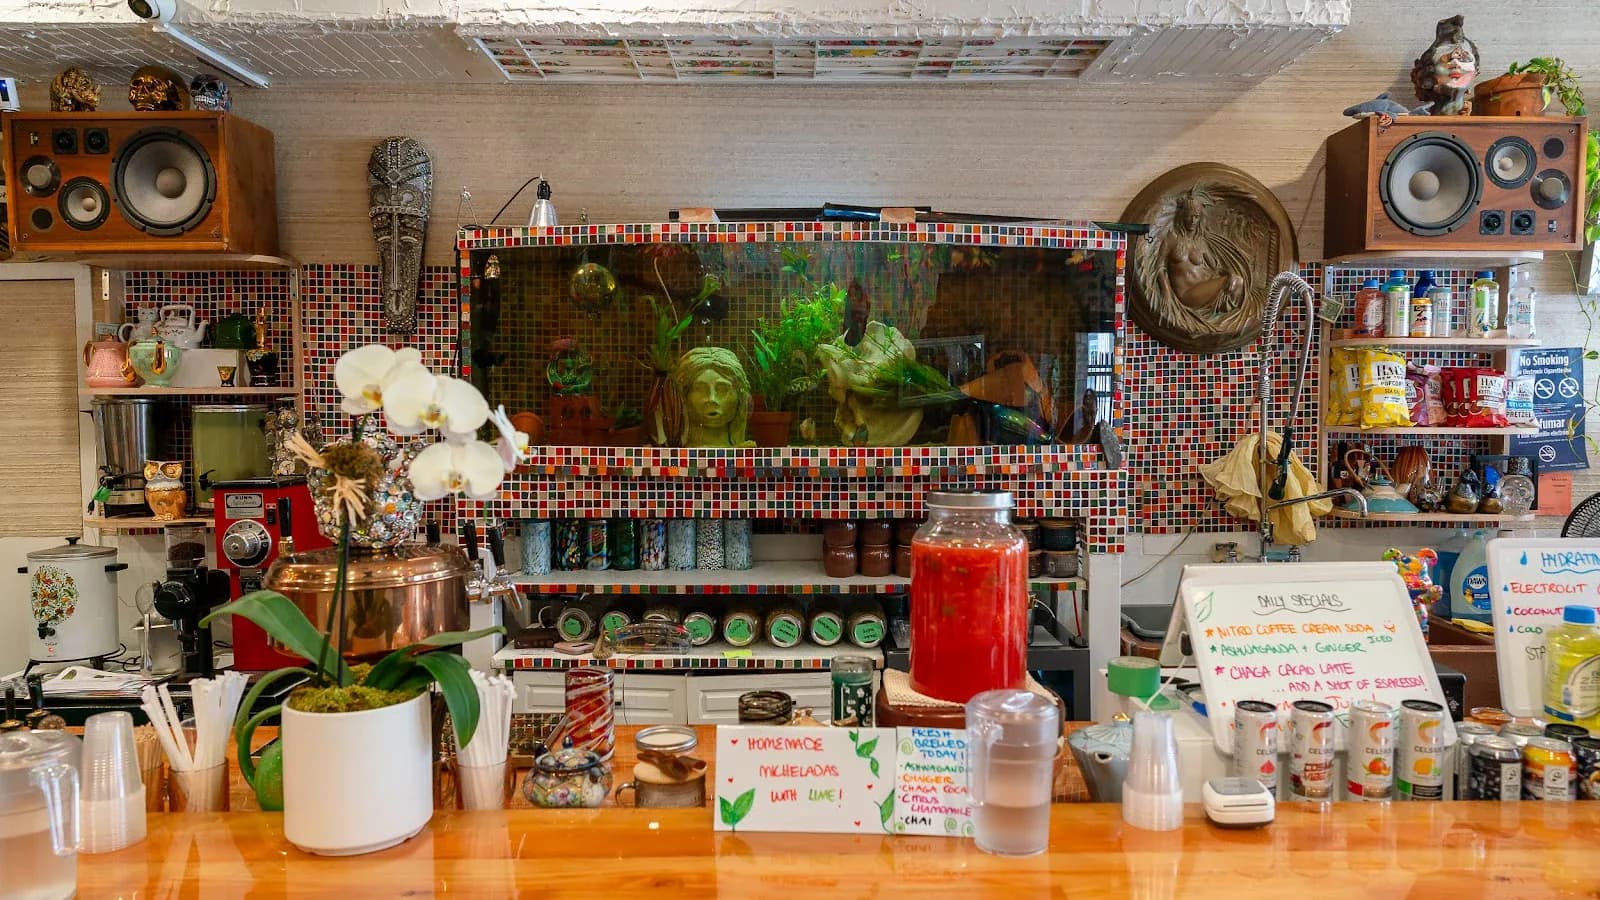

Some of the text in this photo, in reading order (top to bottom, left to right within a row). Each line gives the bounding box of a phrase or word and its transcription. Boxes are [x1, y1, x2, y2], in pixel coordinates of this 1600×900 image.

[1519, 354, 1569, 367] No Smoking
[1510, 582, 1588, 594] ELECTROLIT
[1258, 593, 1343, 608] DAILY SPECIALS
[1513, 607, 1562, 616] COCONUT
[1216, 623, 1375, 639] NITRO COFFEE CREAM SODA
[1315, 642, 1367, 653] GINGER
[1230, 662, 1355, 680] CHAGA CACAO LATTE
[1288, 681, 1311, 692] ADD
[1314, 680, 1323, 692] A
[1326, 681, 1352, 690] SHOT
[1356, 679, 1370, 690] OF
[912, 728, 951, 738] FRESH
[747, 736, 824, 752] HOMEMADE
[914, 738, 965, 749] BREWED
[759, 764, 839, 778] MICHELADAS
[771, 788, 797, 803] WITH
[902, 785, 936, 793] CHAGA
[905, 815, 932, 826] CHAI
